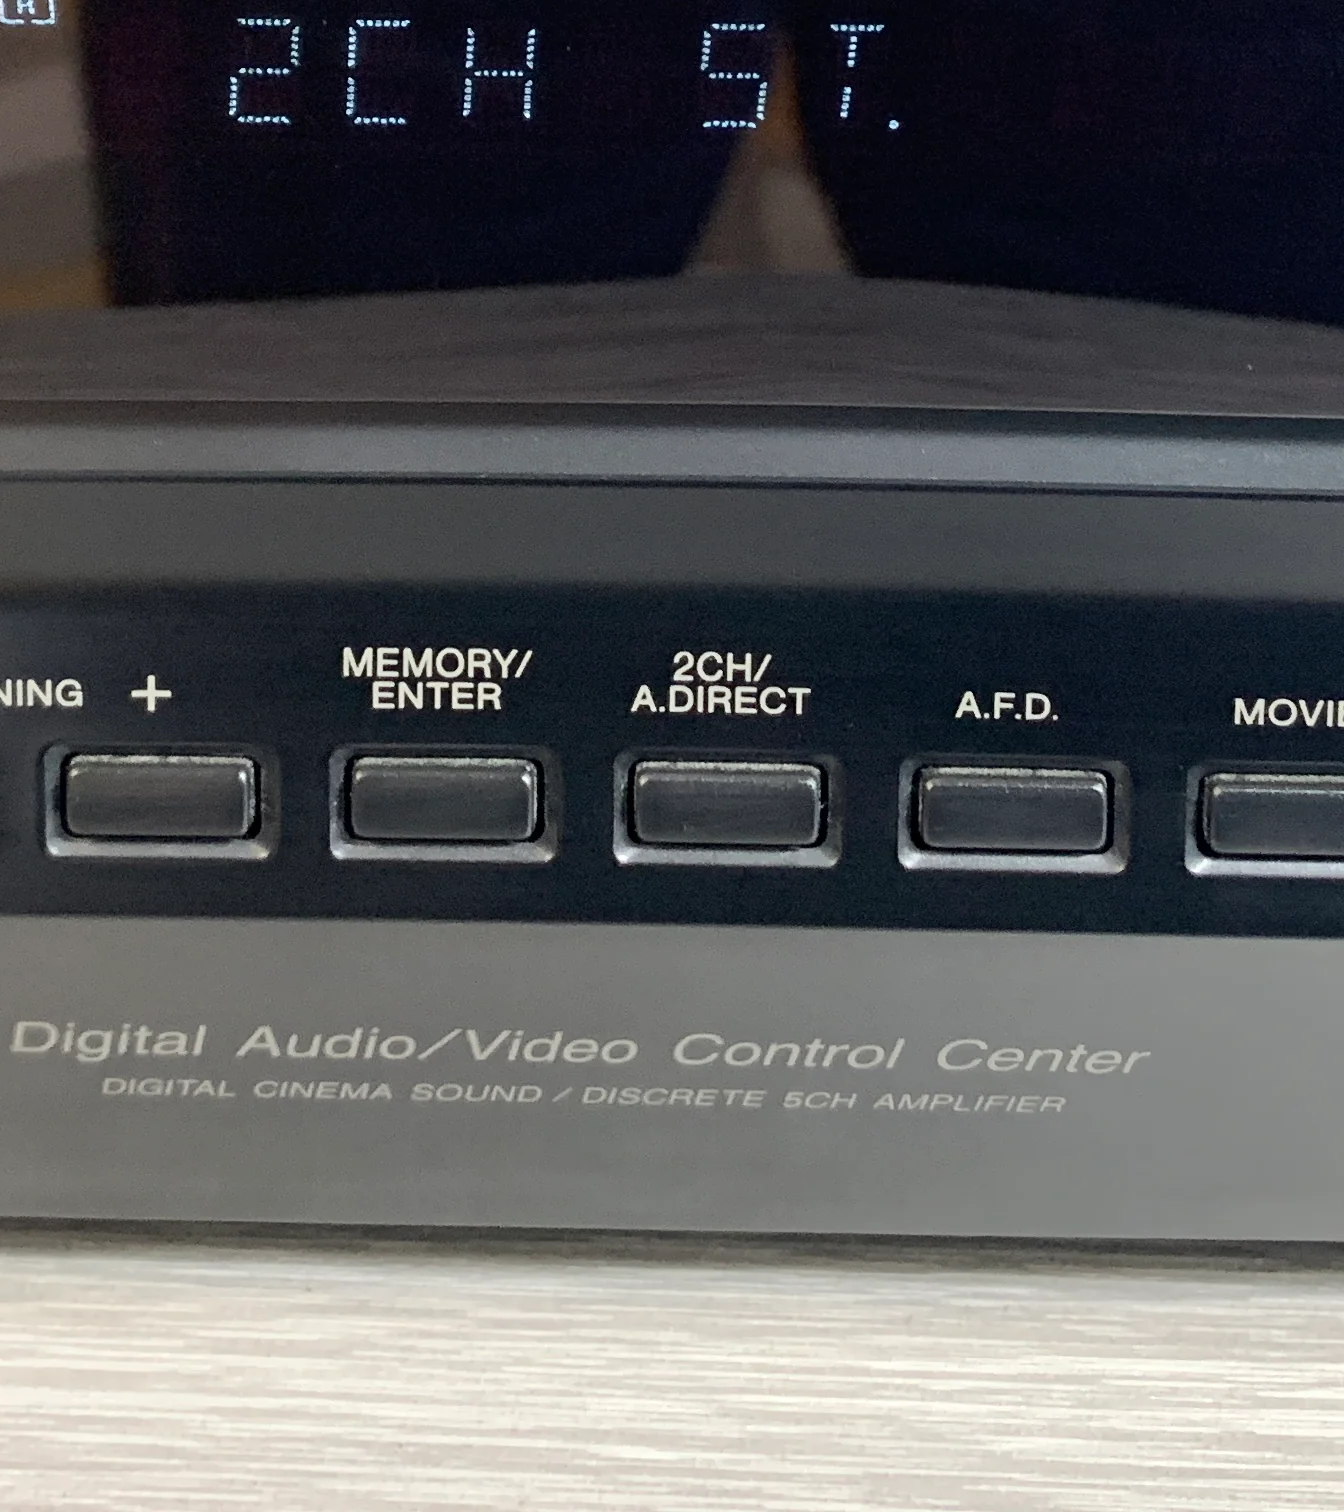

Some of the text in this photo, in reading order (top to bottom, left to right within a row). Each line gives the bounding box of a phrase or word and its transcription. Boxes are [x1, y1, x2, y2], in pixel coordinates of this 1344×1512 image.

[228, 17, 537, 125] 2CH
[341, 647, 533, 680] MEMORY/
[672, 650, 773, 686] 2CH/
[370, 681, 503, 713] ENTER
[630, 685, 812, 718] A.DIRECT
[954, 691, 1059, 724] A.F.D.
[9, 1020, 1152, 1076] Digital Audio/Video Control Center
[101, 1076, 237, 1098] DIGITAL
[253, 1078, 394, 1103] CINEMA
[409, 1082, 544, 1104] SOUND
[581, 1085, 768, 1110] DISCRETE
[871, 1091, 1067, 1115] AMPLIFIER
